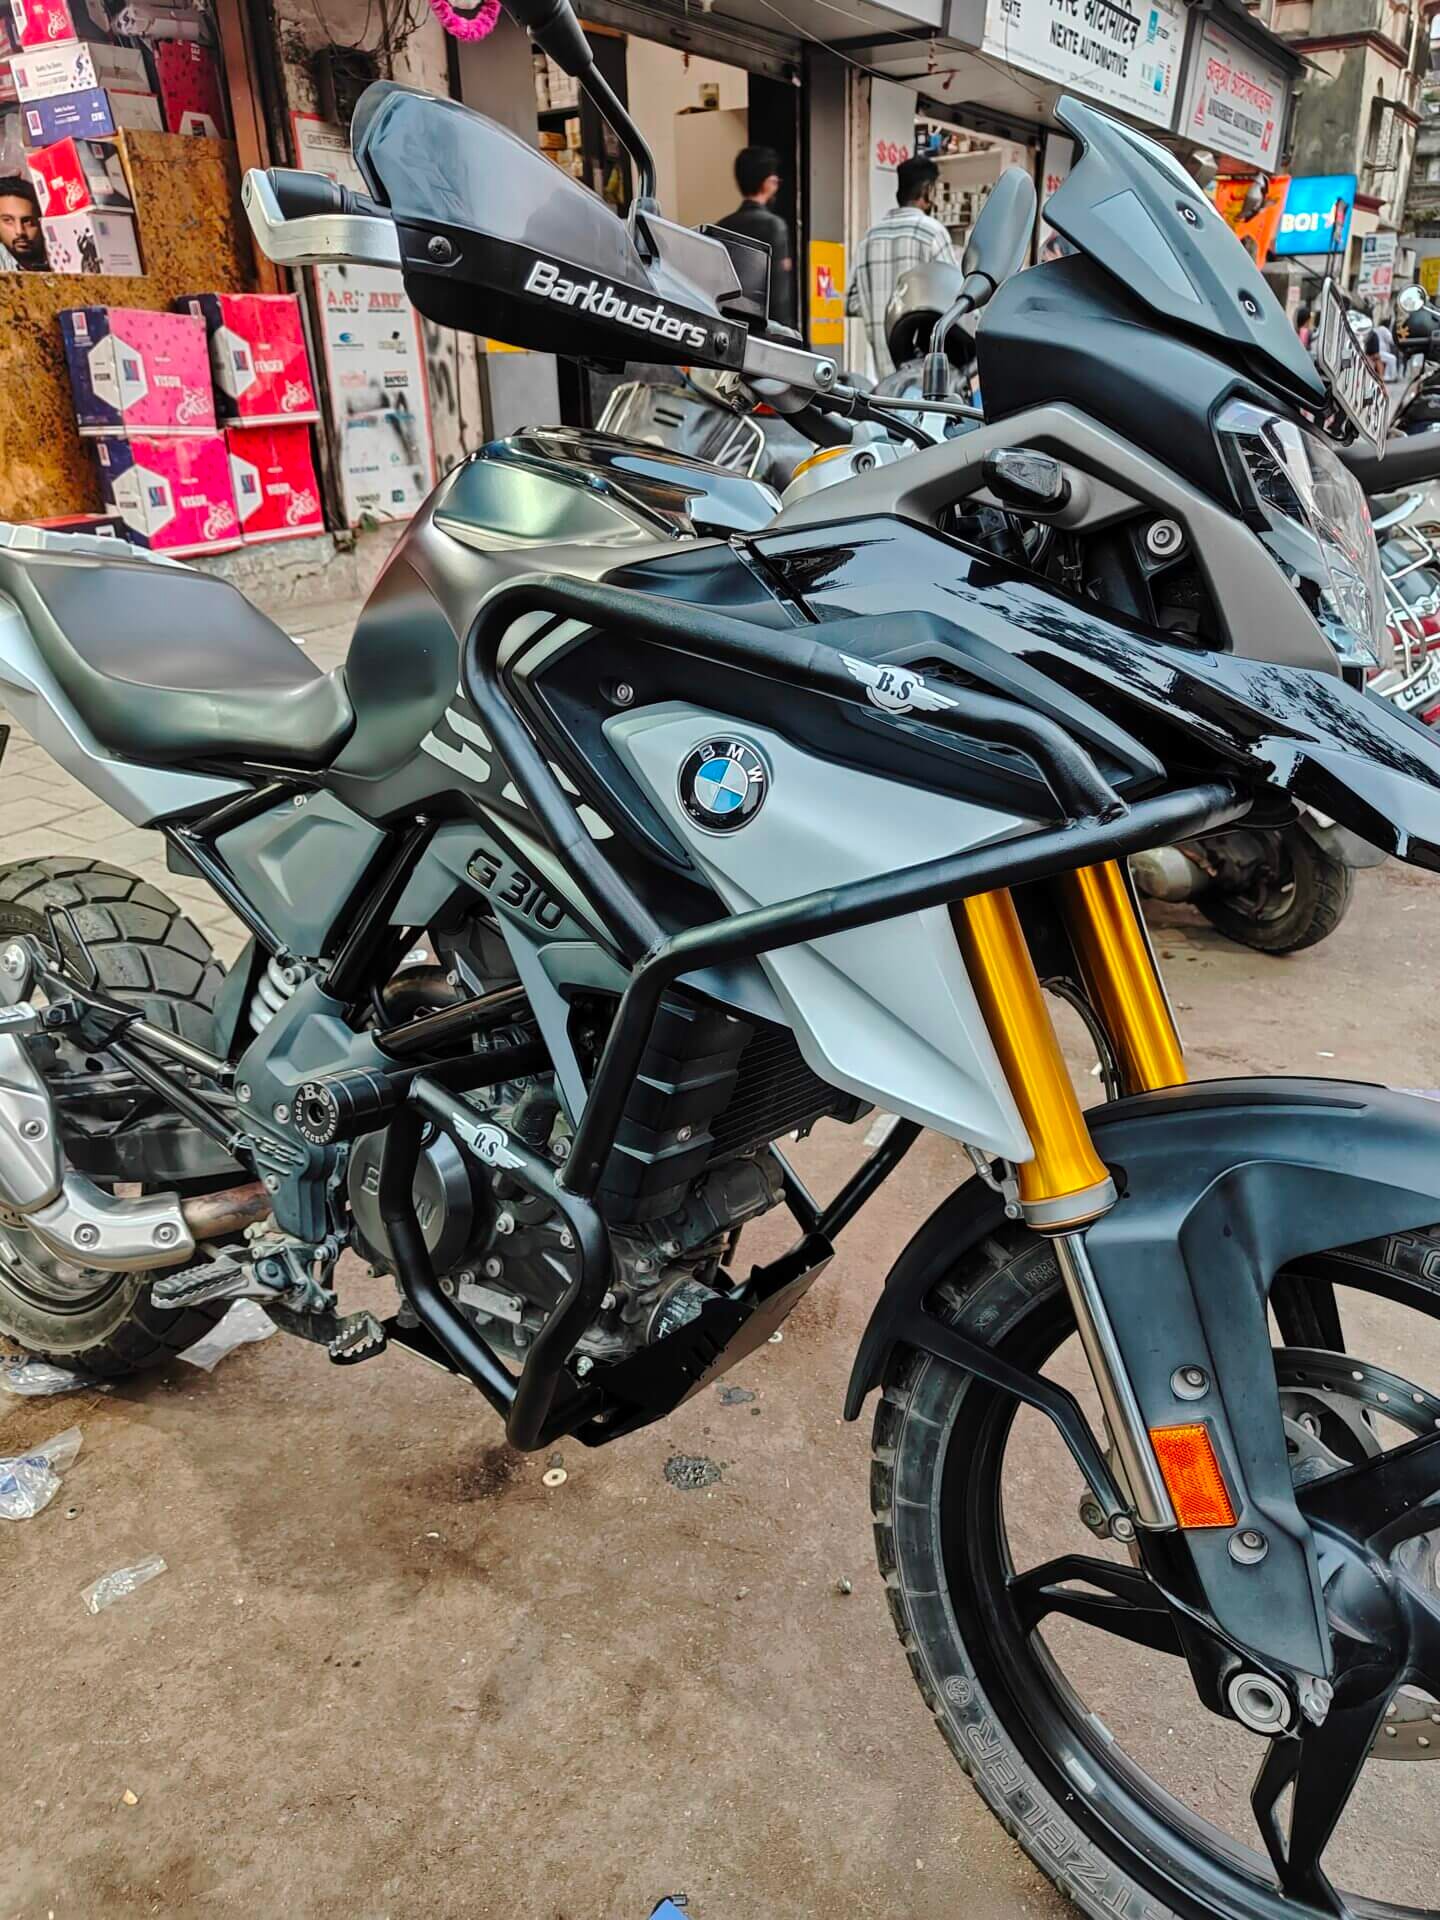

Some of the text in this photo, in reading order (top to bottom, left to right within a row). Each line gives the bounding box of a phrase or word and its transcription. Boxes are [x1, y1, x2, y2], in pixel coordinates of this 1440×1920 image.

[1049, 19, 1079, 55] NEXTE
[1079, 36, 1129, 78] AUTOMOTIVE
[1280, 212, 1319, 233] BOI
[524, 260, 708, 348] Barkbusters
[875, 671, 914, 701] B.S
[1402, 670, 1440, 702] CE.78
[699, 743, 764, 784] BMW
[465, 847, 569, 933] G 310
[300, 1104, 336, 1143] ACCESSORIES
[472, 1132, 500, 1158] B.S
